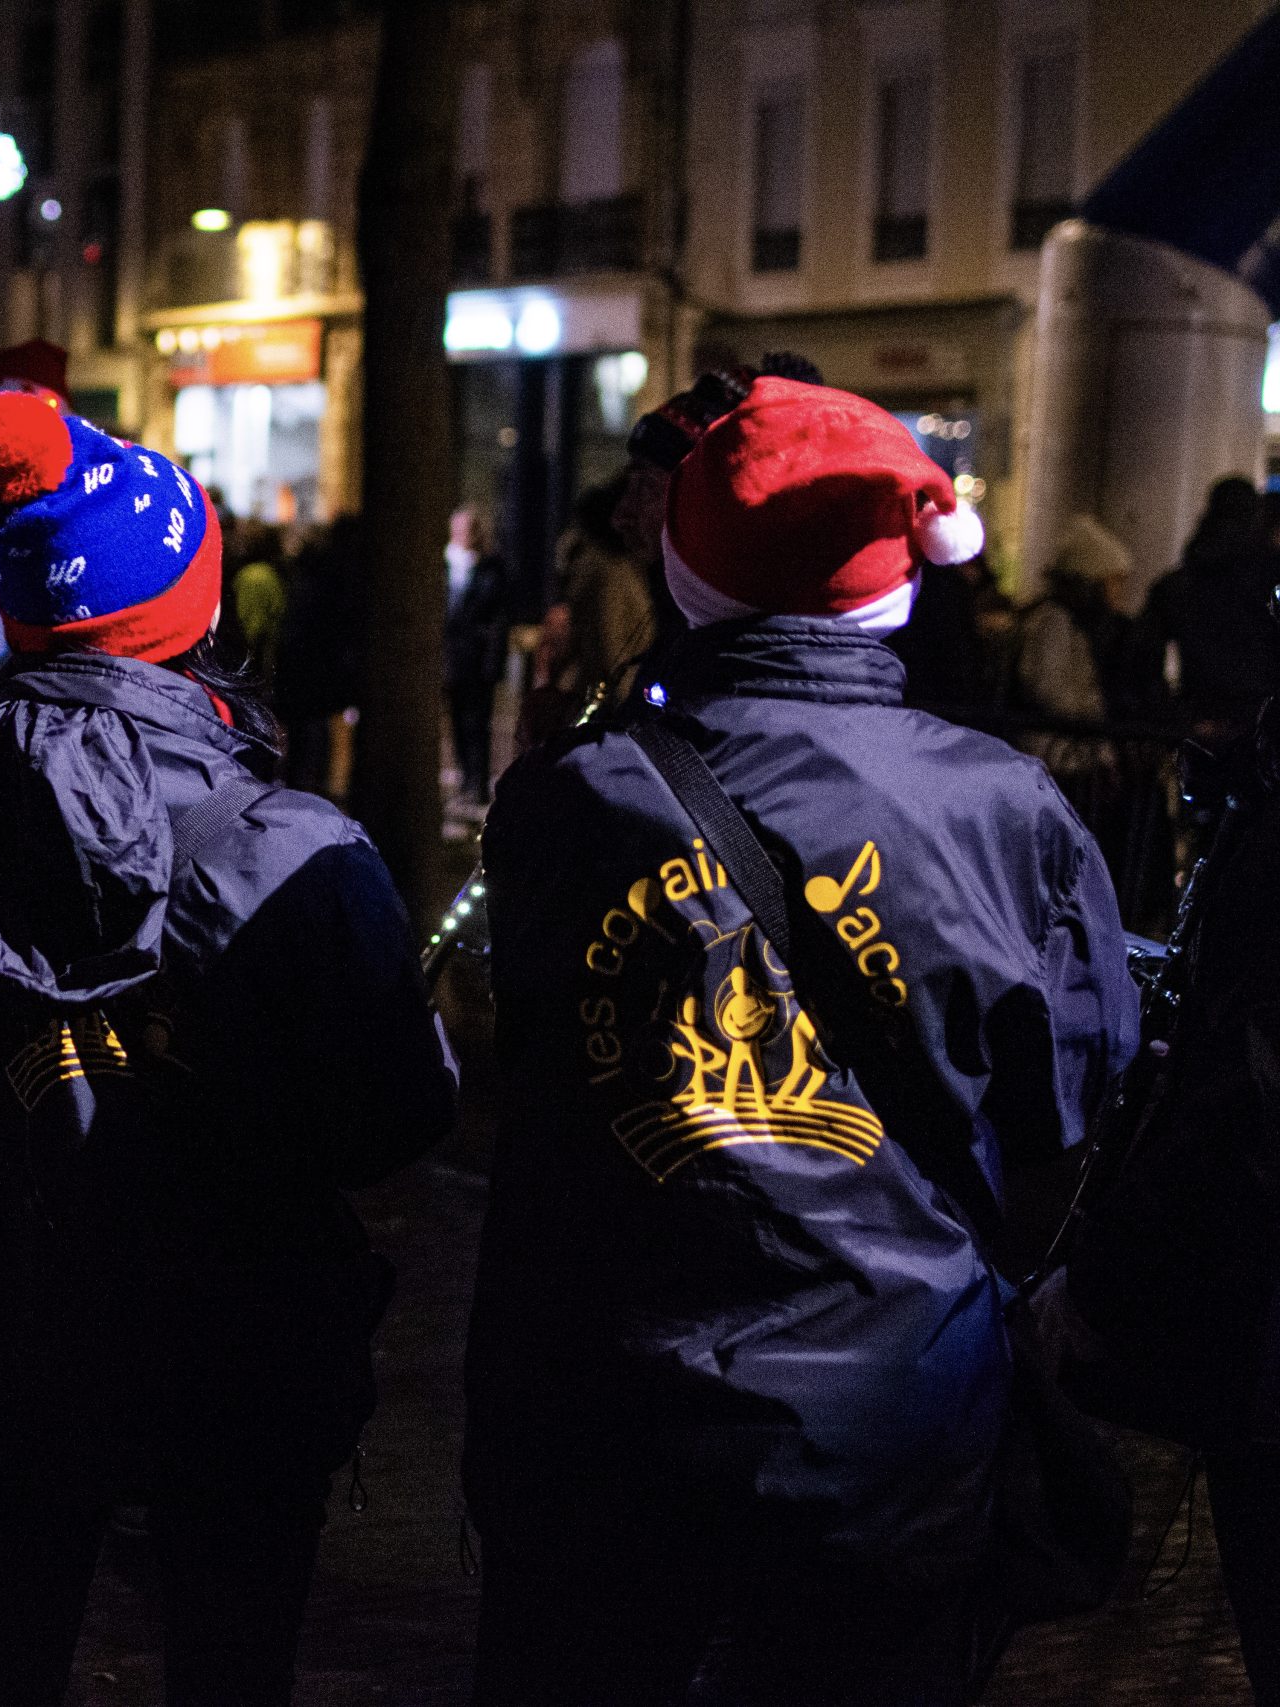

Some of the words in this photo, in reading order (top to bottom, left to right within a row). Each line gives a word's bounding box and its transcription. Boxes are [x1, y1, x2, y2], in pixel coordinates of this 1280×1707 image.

[83, 462, 114, 495] HO
[45, 555, 87, 595] HO
[580, 997, 622, 1086] les
